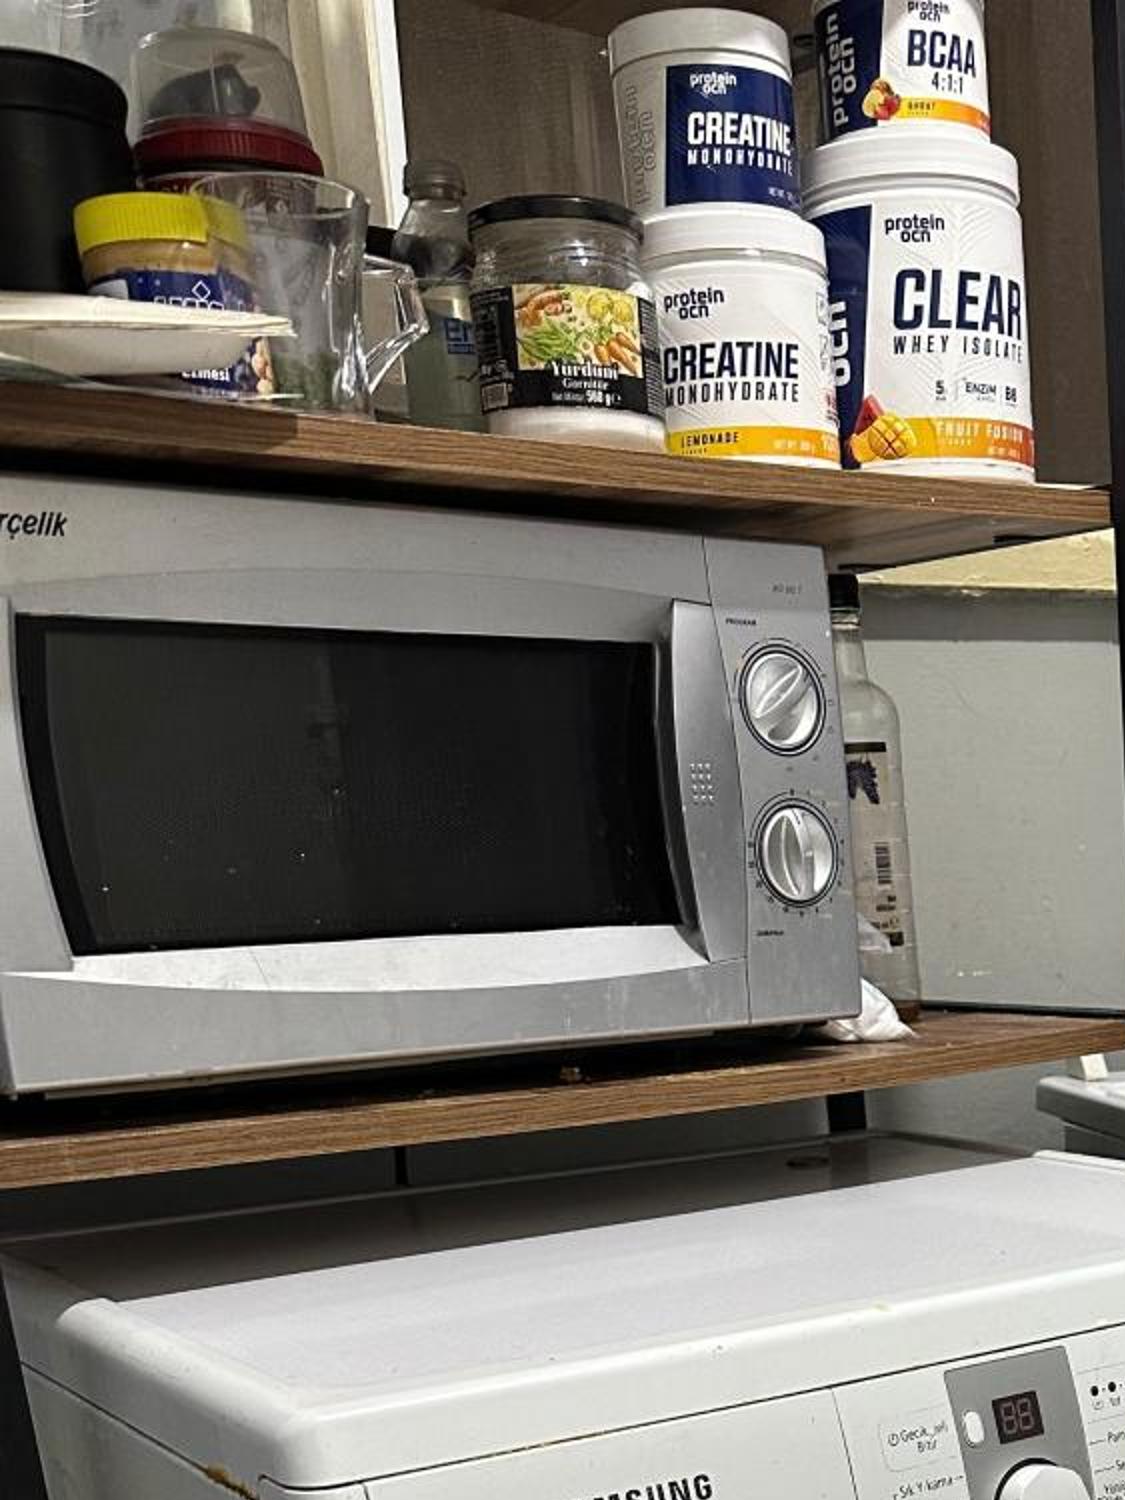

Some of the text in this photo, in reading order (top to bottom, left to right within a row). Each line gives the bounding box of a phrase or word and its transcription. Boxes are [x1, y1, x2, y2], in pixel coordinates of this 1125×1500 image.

[919, 10, 941, 23] ocn
[839, 36, 857, 94] ocn
[907, 29, 977, 79] BCAA
[690, 71, 738, 89] protein
[825, 13, 849, 127] protein
[931, 71, 964, 95] 4:1:1
[702, 83, 728, 96] ocn
[687, 111, 792, 157] CREATINE
[687, 148, 793, 177] MONOHYDRATE
[885, 214, 945, 235] protein
[900, 228, 931, 243] ocn
[664, 287, 725, 313] protein
[679, 305, 709, 321] ocn
[893, 268, 1022, 341] CLEAR
[663, 341, 799, 385] CREATINE
[893, 334, 1024, 365] WHEY ISOLATE
[665, 381, 799, 408] MONOHYDRATE
[681, 431, 740, 449] LEMONADE
[0, 511, 68, 540] rçelik
